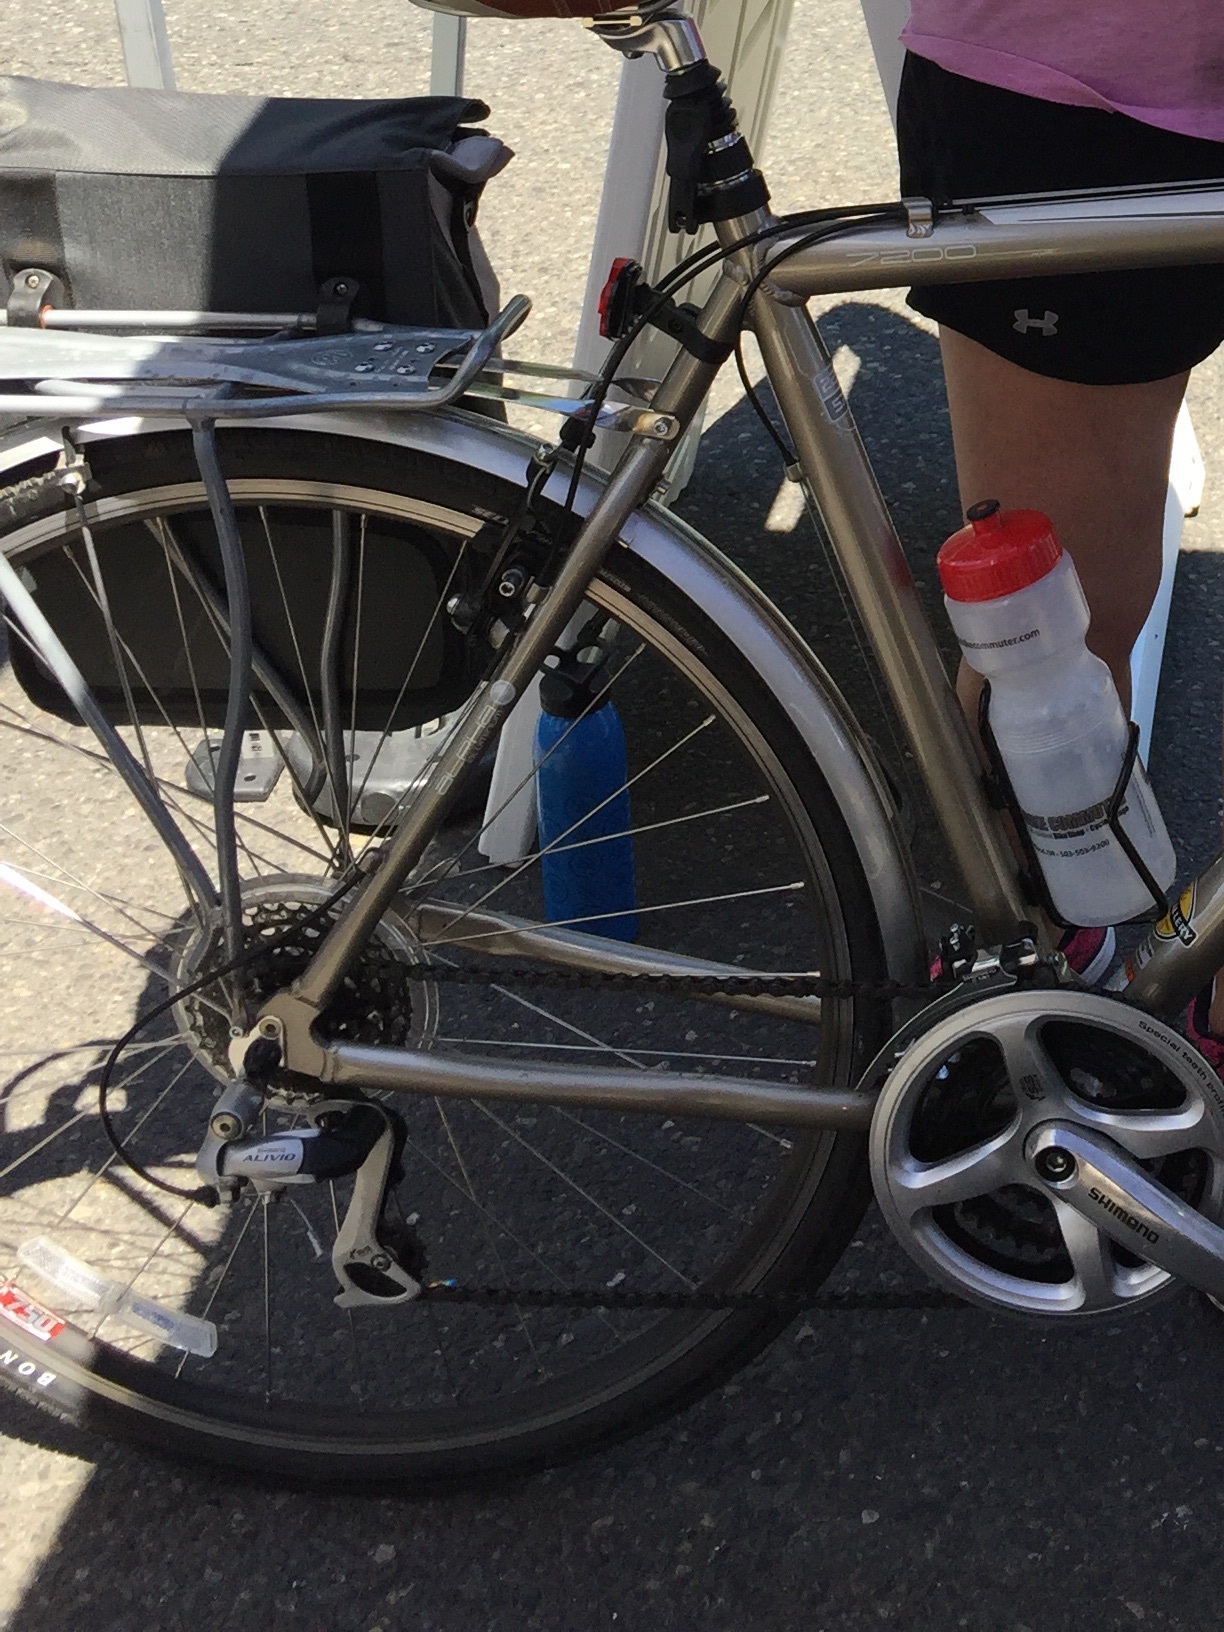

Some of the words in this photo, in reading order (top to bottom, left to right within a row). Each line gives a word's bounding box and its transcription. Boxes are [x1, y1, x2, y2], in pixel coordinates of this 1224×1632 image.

[846, 244, 977, 268] 7200
[1138, 1020, 1181, 1053] Special
[1182, 1051, 1207, 1081] tooth
[243, 1153, 296, 1163] ALIVIO
[1088, 1186, 1160, 1245] SHIMANO
